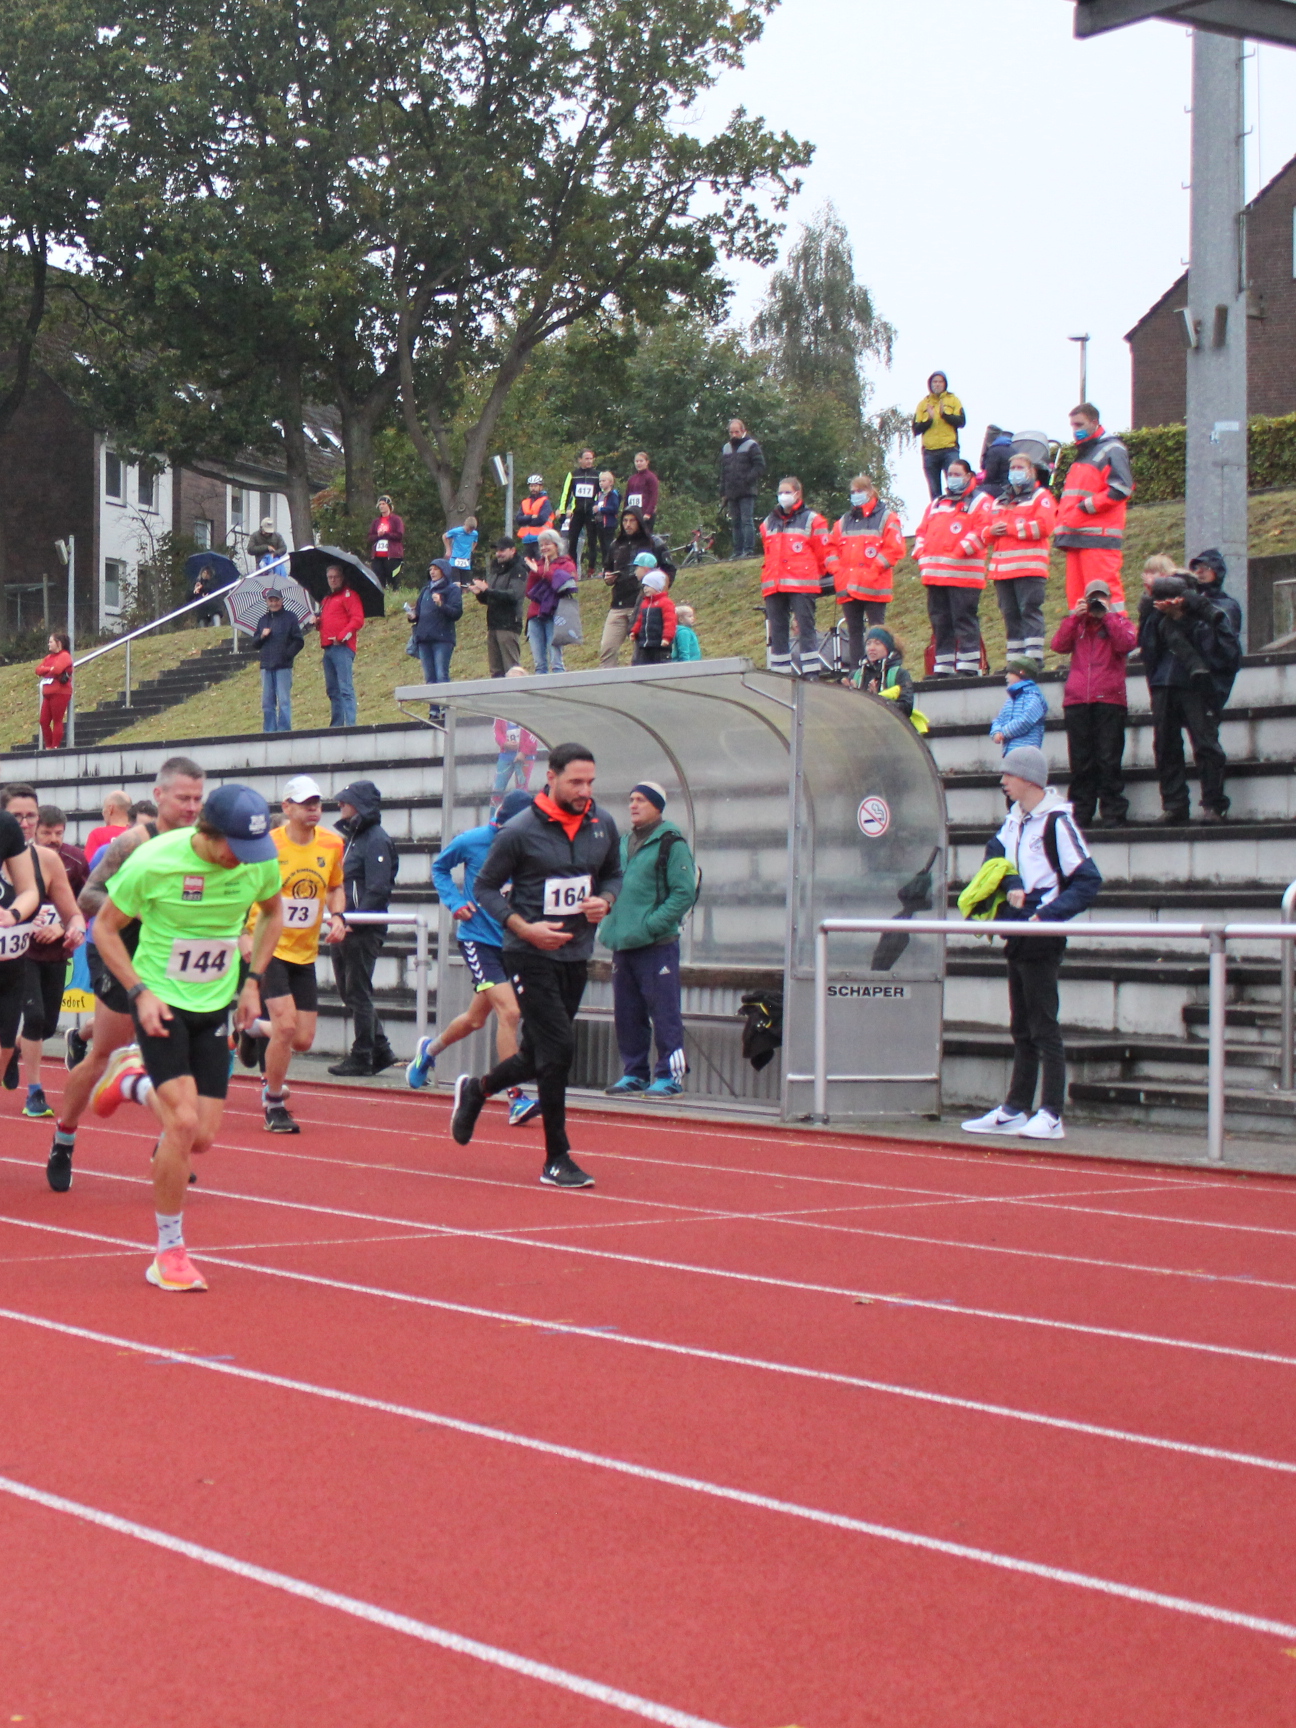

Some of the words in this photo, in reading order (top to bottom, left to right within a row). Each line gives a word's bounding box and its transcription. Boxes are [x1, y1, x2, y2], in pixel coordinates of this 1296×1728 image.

[551, 886, 586, 907] 164
[288, 906, 310, 922] 73
[178, 949, 227, 973] 144
